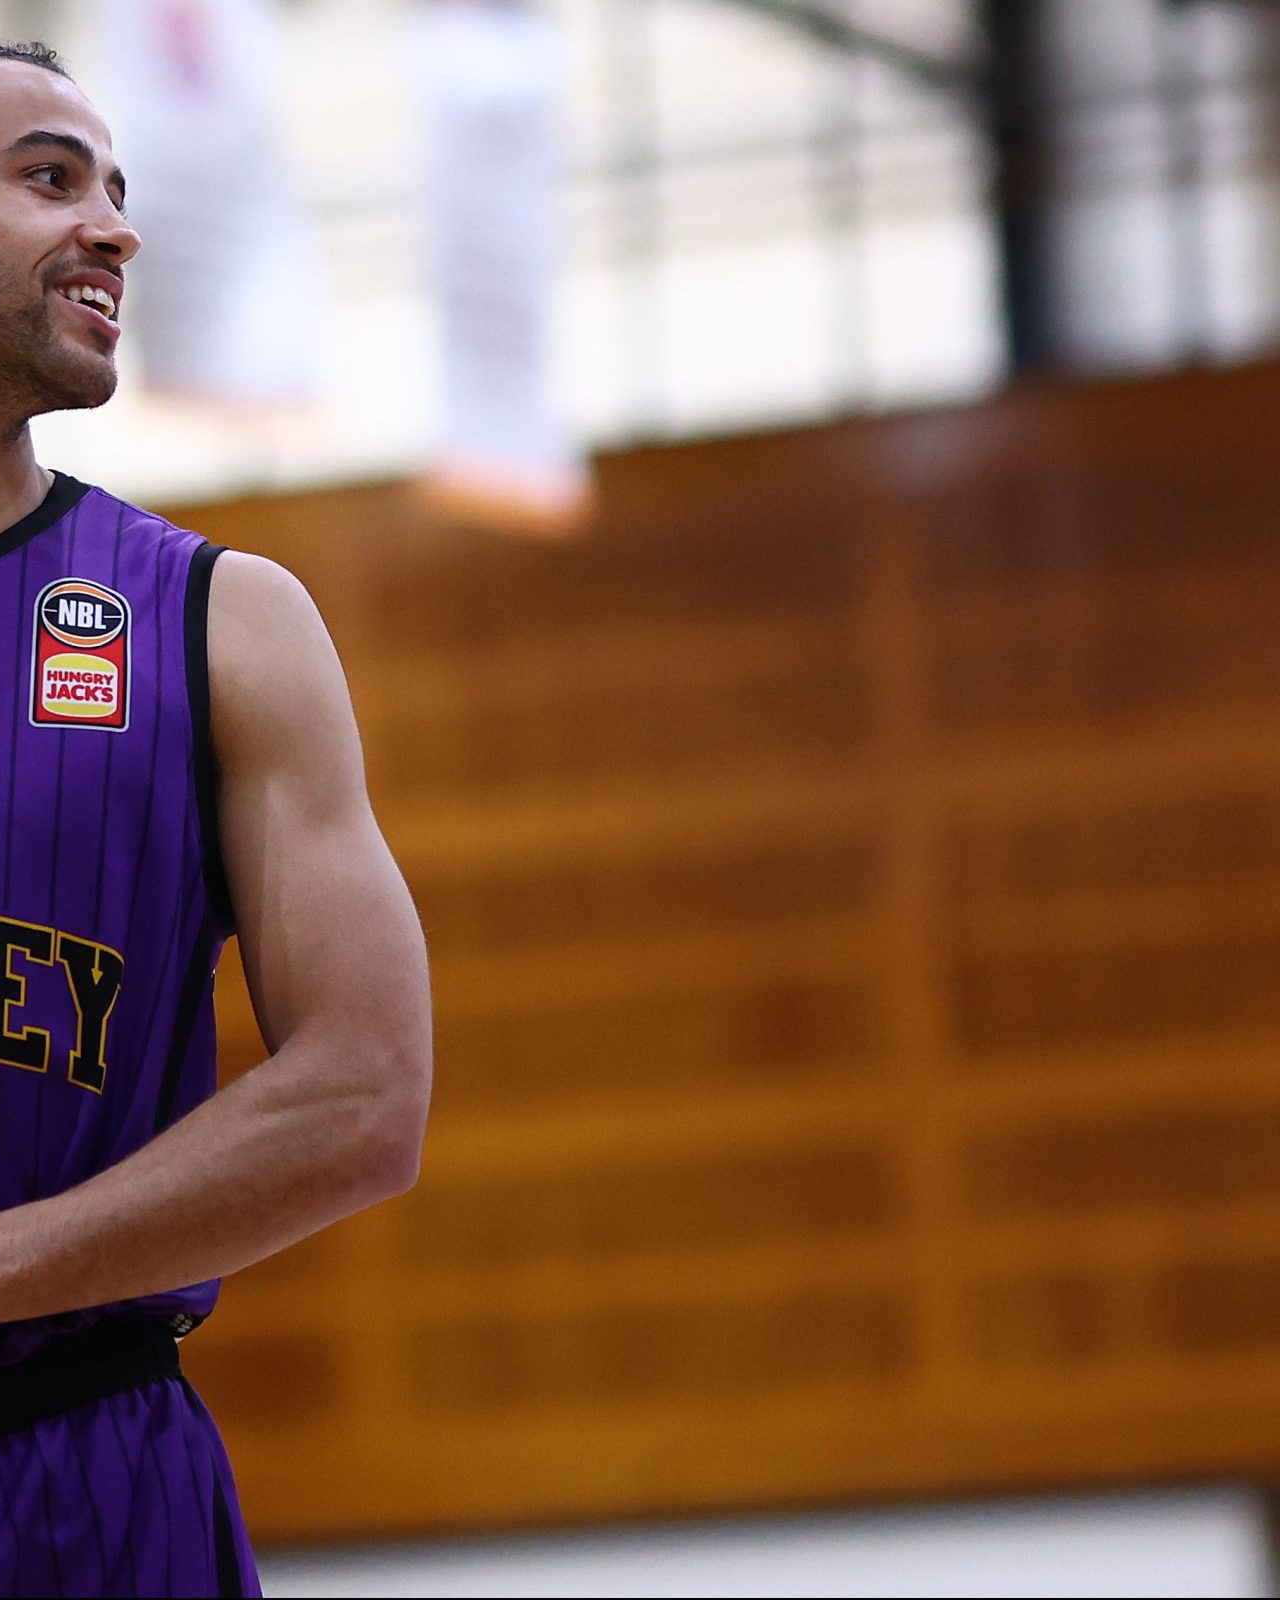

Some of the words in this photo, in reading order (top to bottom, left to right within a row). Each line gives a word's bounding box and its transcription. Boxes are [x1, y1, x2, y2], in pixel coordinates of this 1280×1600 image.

[58, 598, 107, 630] NBL
[46, 670, 114, 686] HUNGRY
[46, 683, 114, 703] JACK'S
